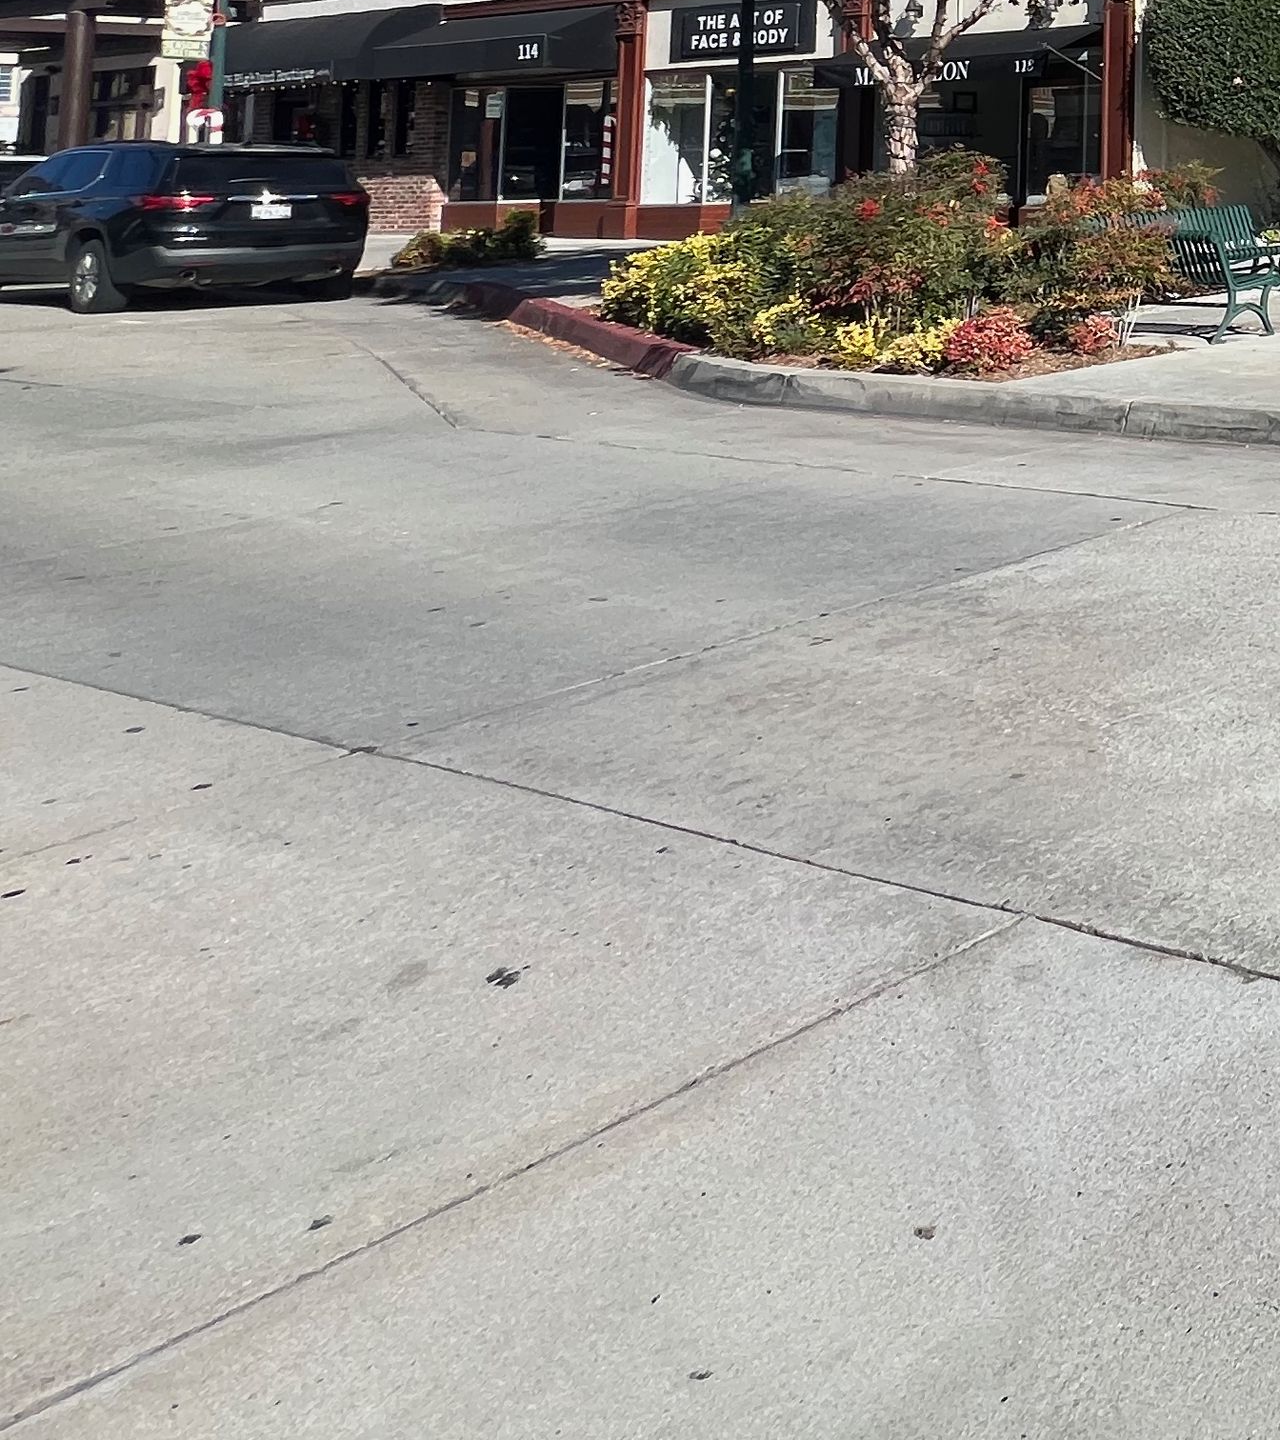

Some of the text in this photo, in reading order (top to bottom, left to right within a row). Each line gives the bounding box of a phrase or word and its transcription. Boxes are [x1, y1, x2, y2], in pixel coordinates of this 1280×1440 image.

[697, 9, 785, 31] THE AT OF
[690, 32, 728, 50] FACE
[517, 43, 539, 60] 114
